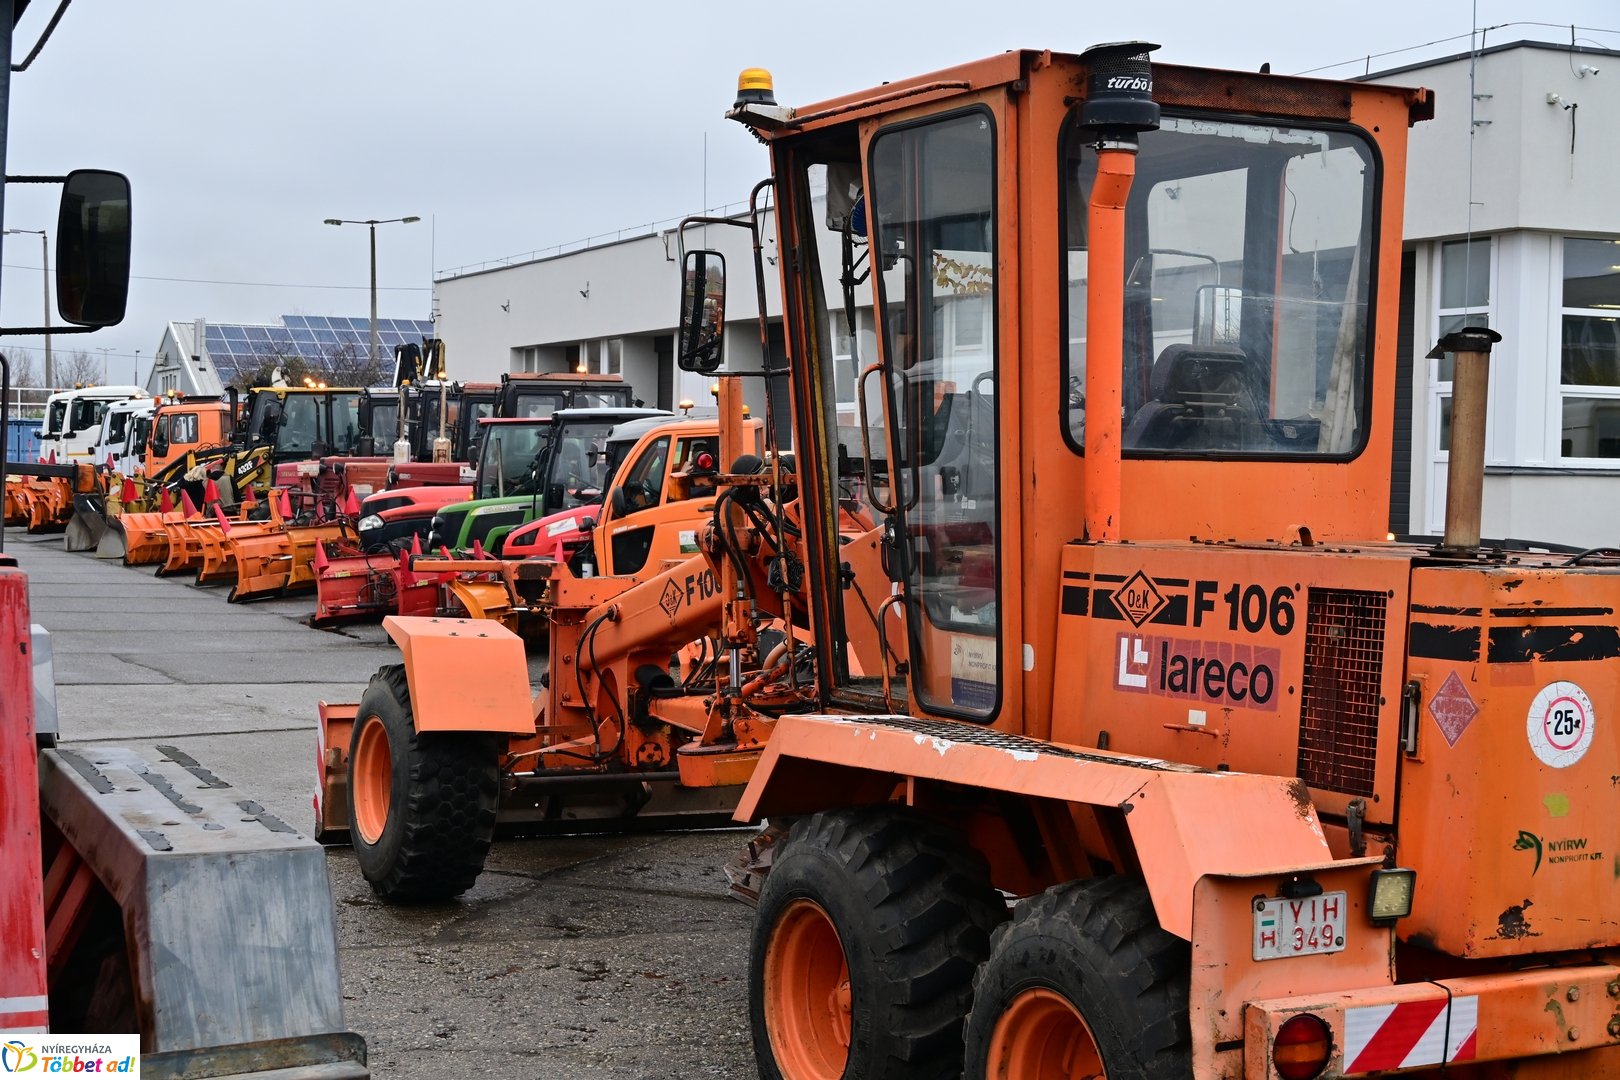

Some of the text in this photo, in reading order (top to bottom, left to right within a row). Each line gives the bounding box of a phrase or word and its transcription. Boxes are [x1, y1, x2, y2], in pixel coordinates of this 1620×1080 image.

[1107, 76, 1147, 91] turbo
[238, 461, 253, 475] 432F
[685, 574, 695, 606] F
[1127, 589, 1150, 610] O&K
[1193, 580, 1295, 636] F 106
[1159, 641, 1274, 705] lareco
[1554, 709, 1573, 735] 25
[1548, 853, 1589, 864] NONPROFIT
[1289, 896, 1339, 924] YIH
[1260, 930, 1276, 949] H
[1292, 924, 1334, 952] 349
